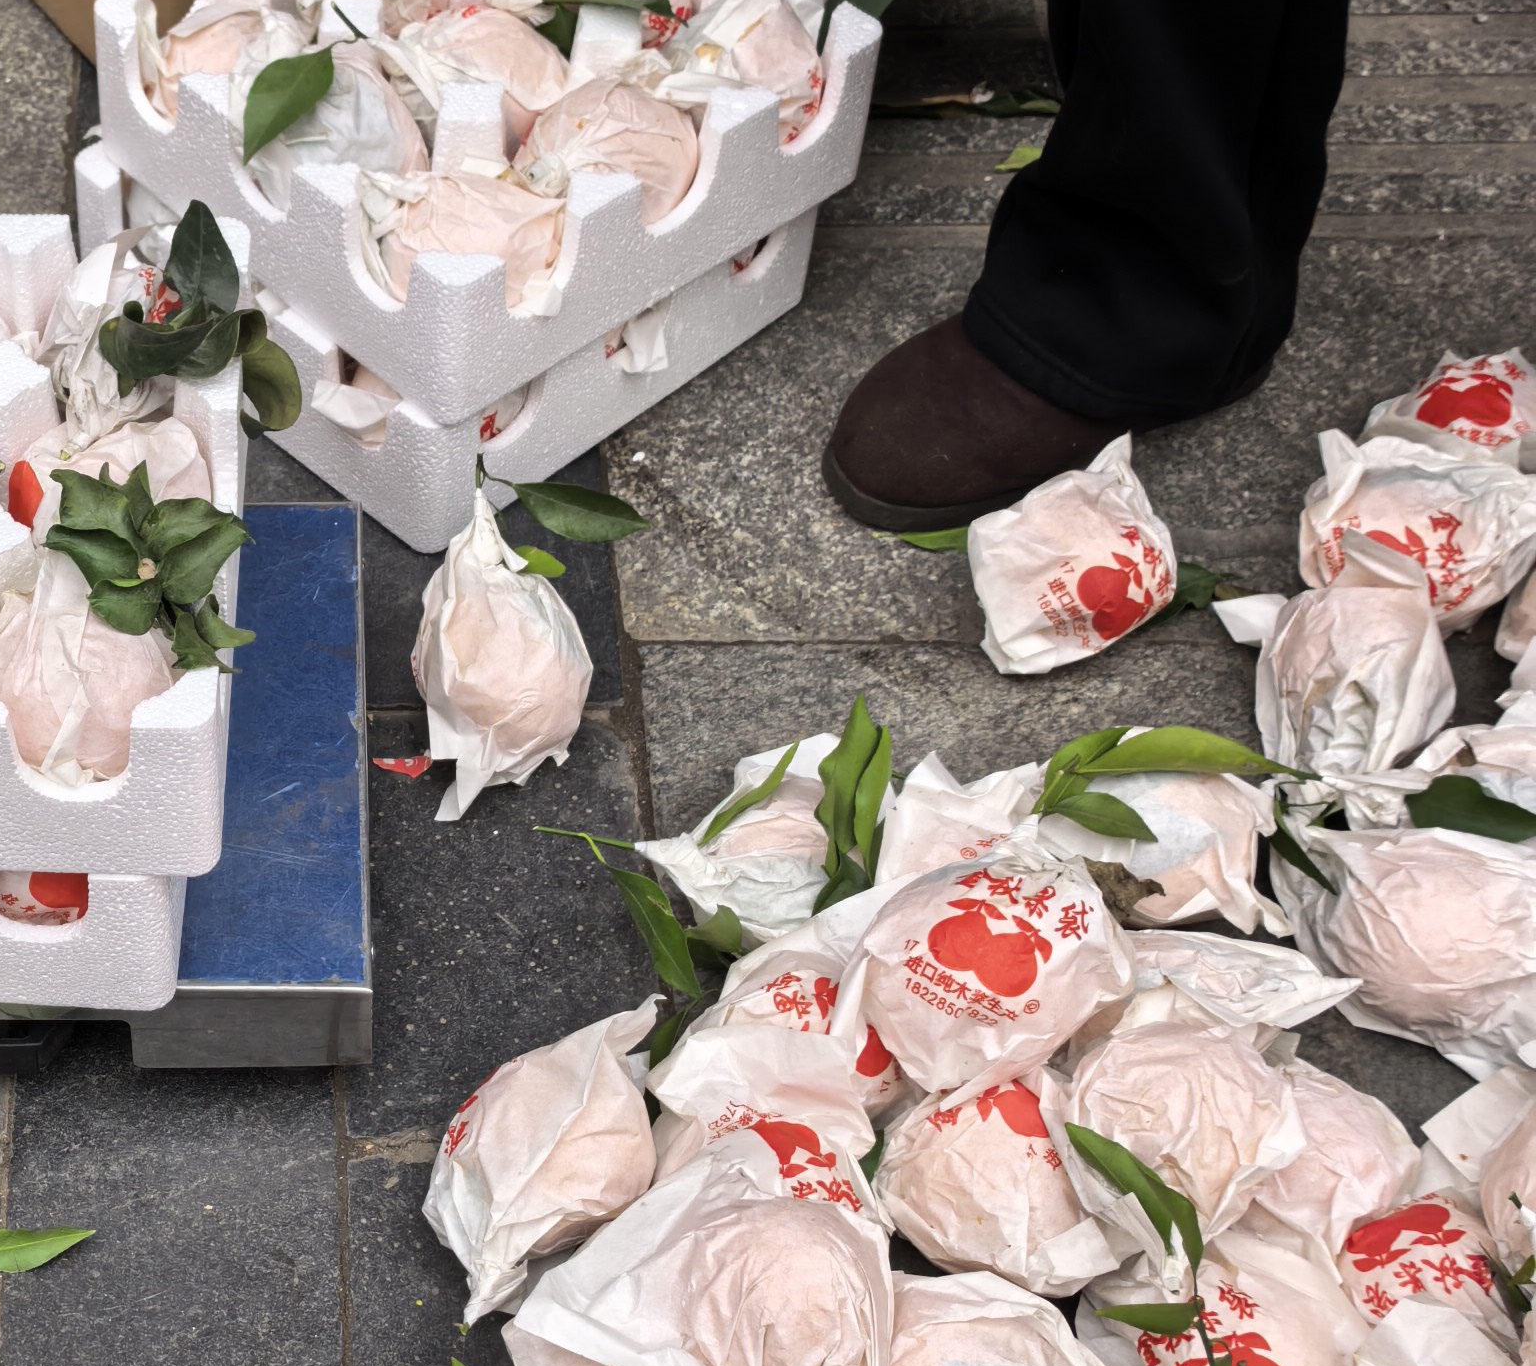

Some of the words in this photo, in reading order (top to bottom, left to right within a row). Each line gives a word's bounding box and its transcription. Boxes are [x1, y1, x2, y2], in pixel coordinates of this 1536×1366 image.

[1058, 560, 1076, 576] 17
[955, 867, 1093, 941] 金秋果袋
[903, 938, 920, 952] 17
[901, 953, 1021, 1023] 进口纯木浆生产
